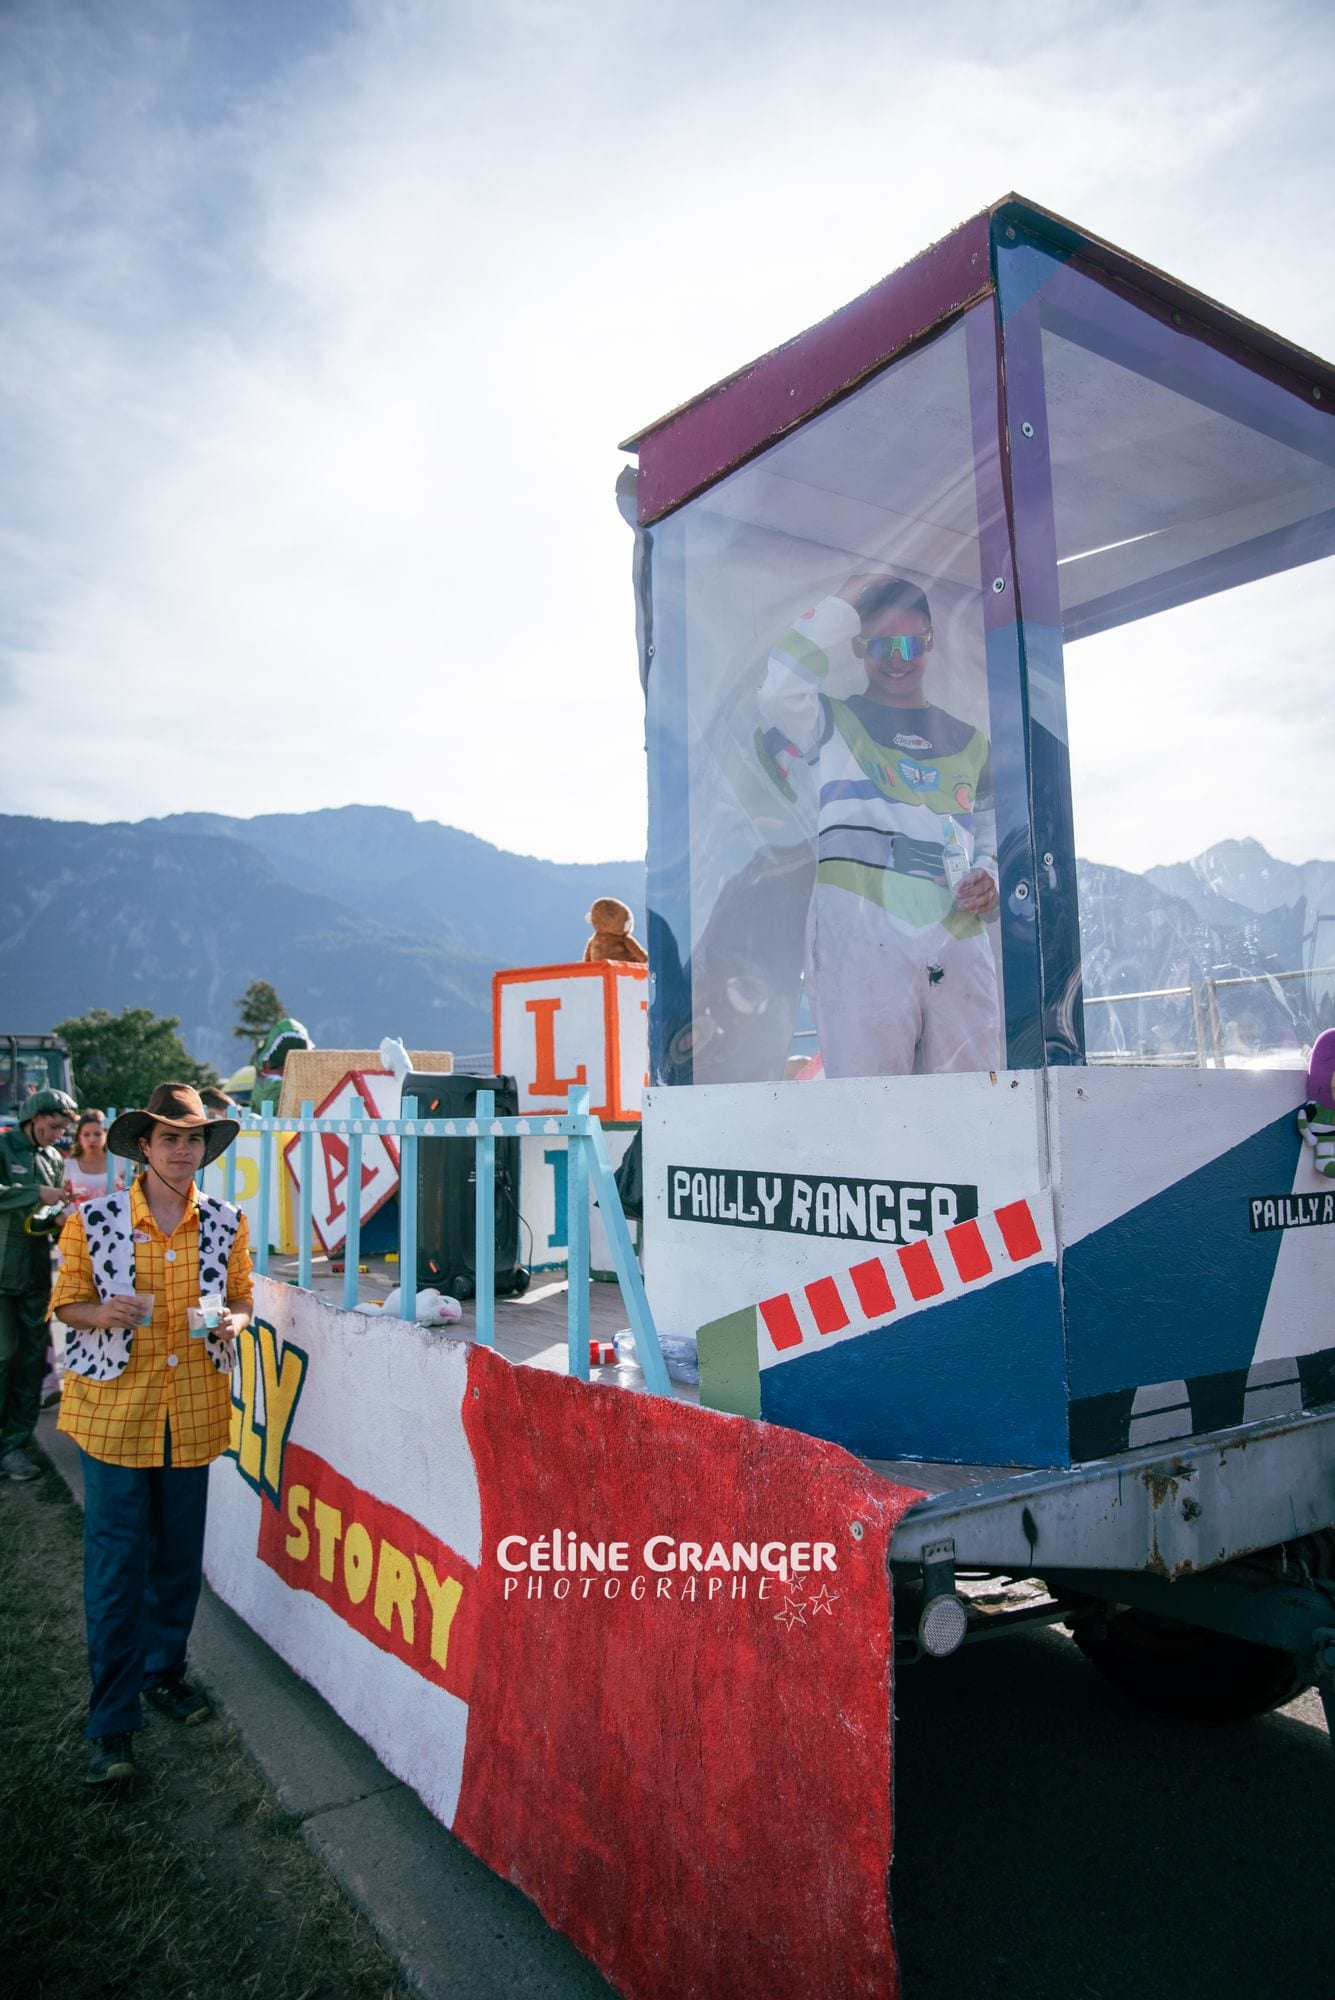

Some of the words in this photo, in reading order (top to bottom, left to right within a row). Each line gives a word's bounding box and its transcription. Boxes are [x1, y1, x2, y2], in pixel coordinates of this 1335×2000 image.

[525, 998, 586, 1096] L
[317, 1131, 380, 1226] A
[673, 1170, 783, 1225] PAILLY
[791, 1179, 958, 1243] RANGER
[1252, 1197, 1320, 1229] PAILLY
[285, 1484, 464, 1670] STORY
